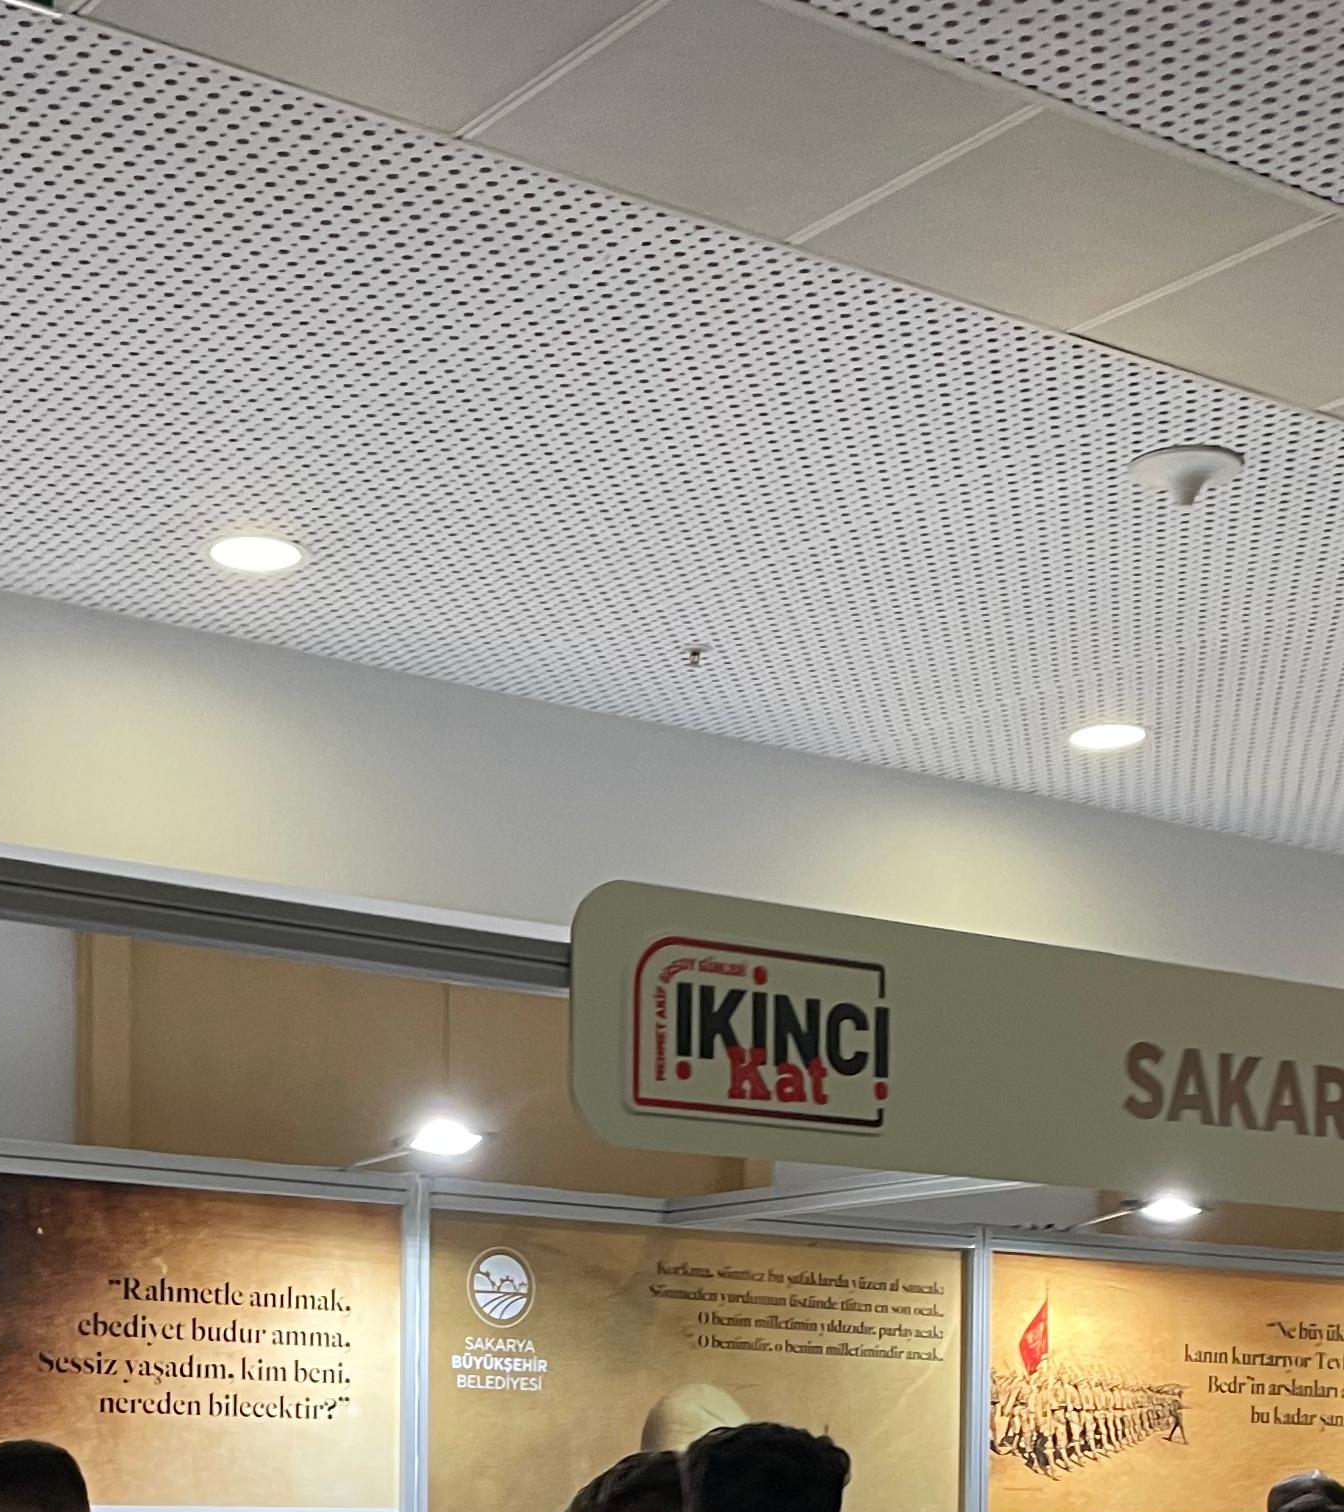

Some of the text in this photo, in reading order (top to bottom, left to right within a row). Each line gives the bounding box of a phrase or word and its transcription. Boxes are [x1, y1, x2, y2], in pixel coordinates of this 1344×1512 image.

[726, 1044, 829, 1106] Kat
[767, 1269, 784, 1284] bu
[78, 1312, 185, 1346] ebediyet
[191, 1317, 267, 1343] budur
[697, 1311, 709, 1326] O
[711, 1311, 752, 1328] benim
[464, 1336, 536, 1354] SAKARYA
[697, 1335, 709, 1349] O
[785, 1339, 824, 1356] benim
[38, 1351, 118, 1376] Sessiz
[240, 1356, 287, 1382] kim
[451, 1352, 548, 1373] BÜYÜKŞEHİR
[1184, 1344, 1228, 1364] kanın
[1231, 1345, 1312, 1373] kurtarıyor
[456, 1373, 543, 1391] BELEDİYESİ
[1268, 1379, 1338, 1399] arslanları
[99, 1391, 202, 1416] nereden
[1250, 1405, 1270, 1424] bu
[1273, 1406, 1318, 1426] kadar
